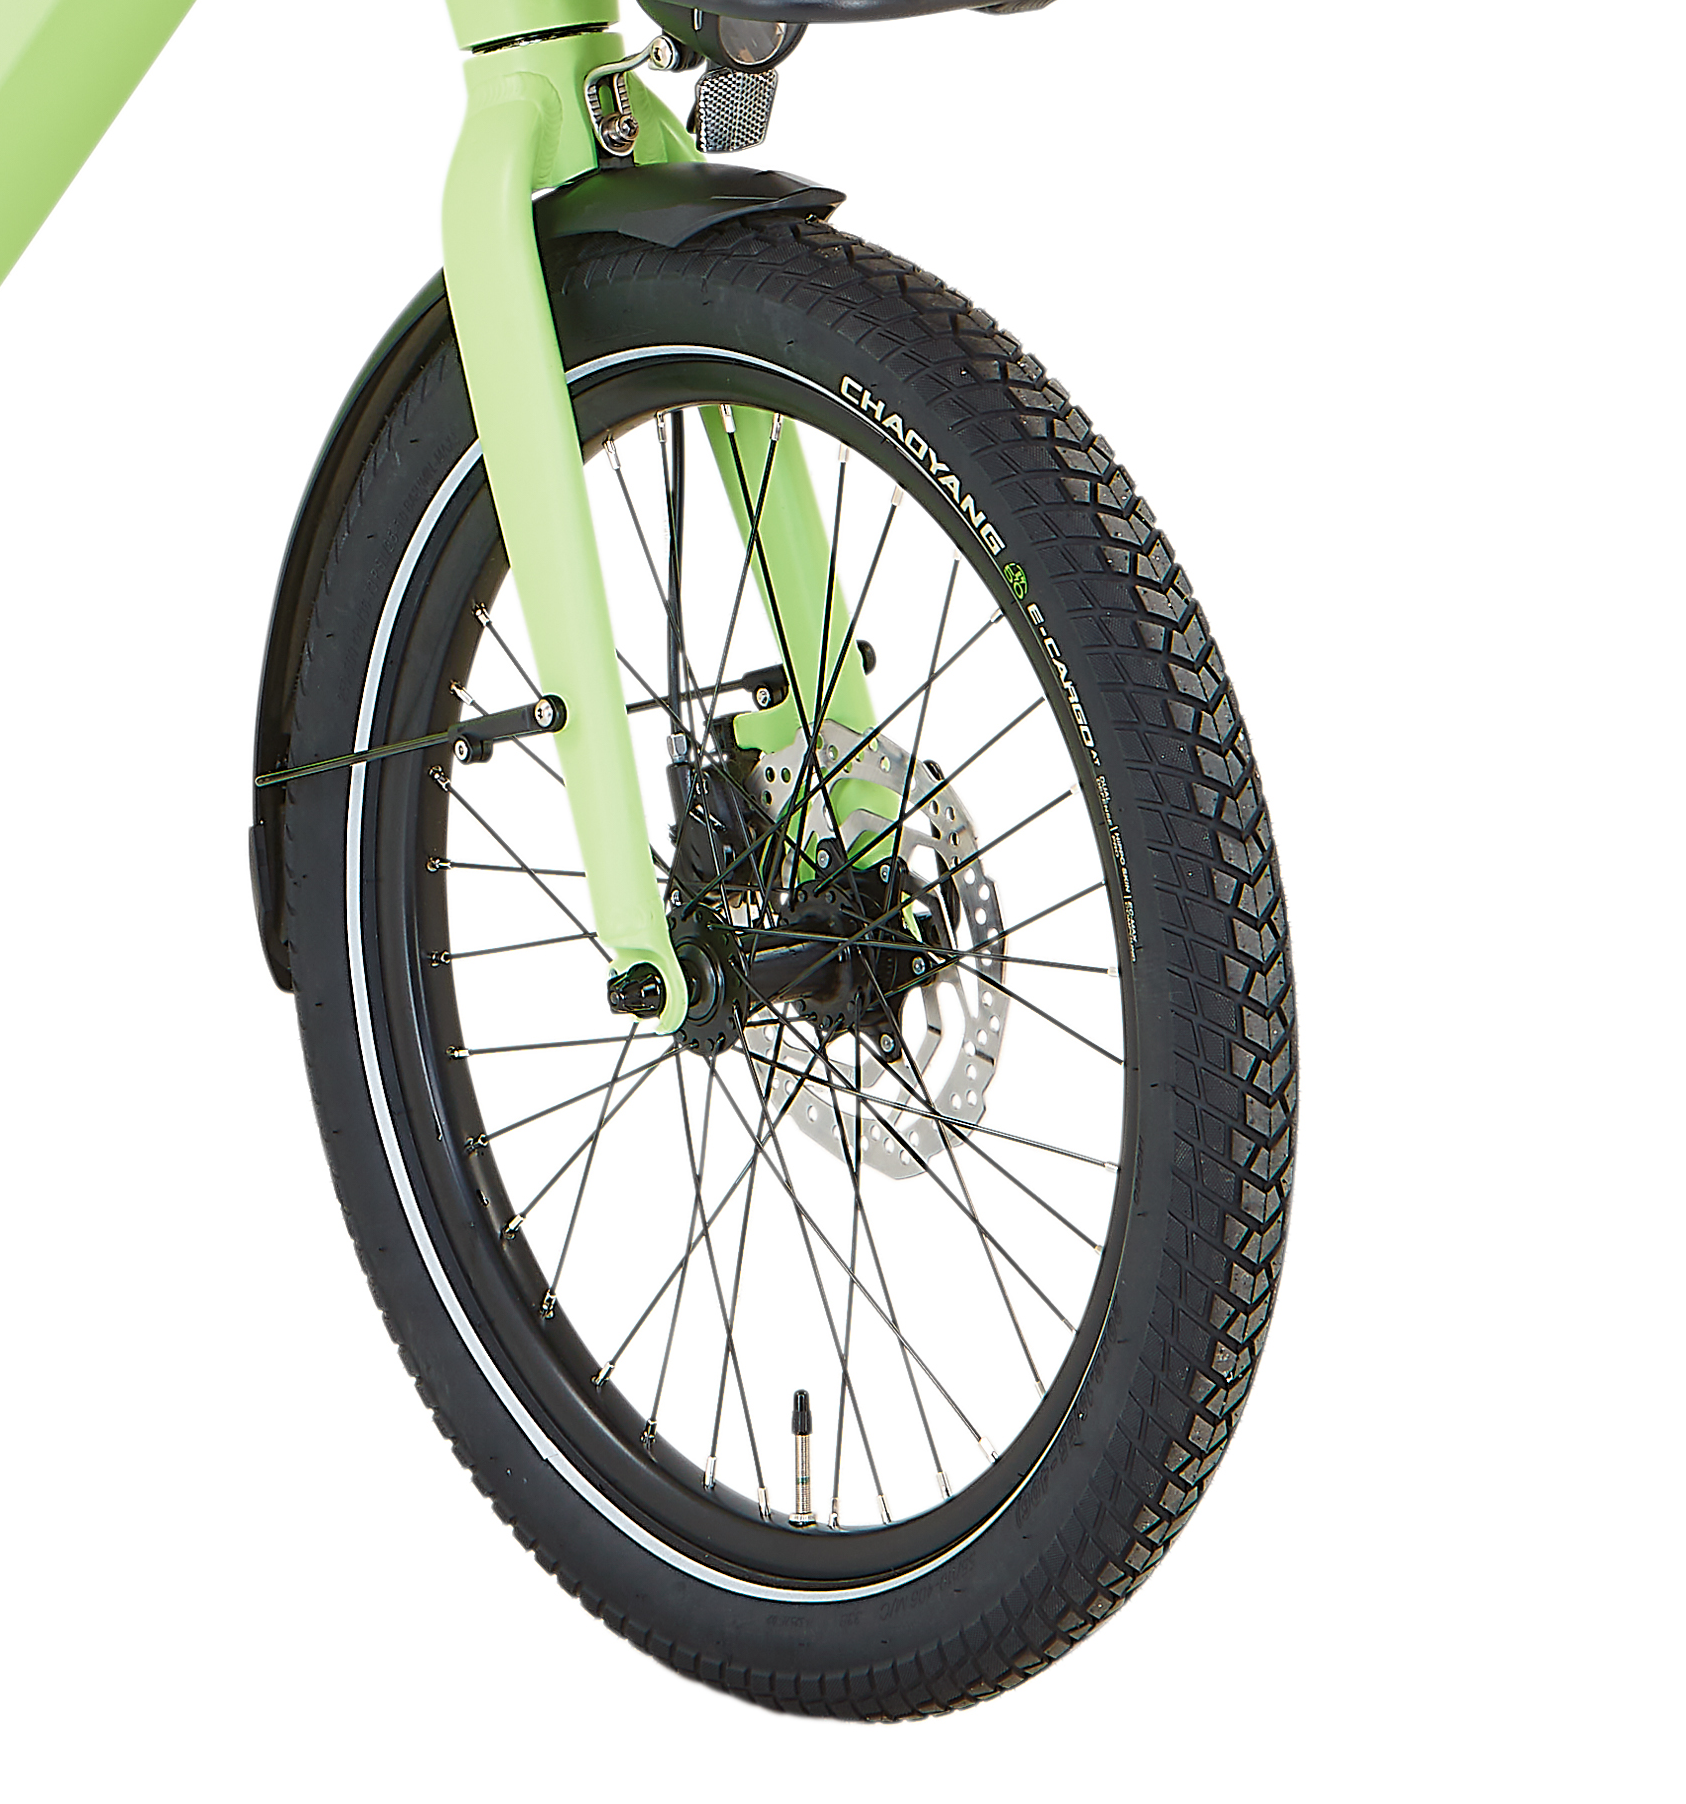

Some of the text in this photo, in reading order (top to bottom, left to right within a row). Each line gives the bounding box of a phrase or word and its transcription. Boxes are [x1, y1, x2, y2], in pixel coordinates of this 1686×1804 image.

[840, 375, 1006, 556] CHAOYANG
[1027, 602, 1101, 767] E-CARGO AT
